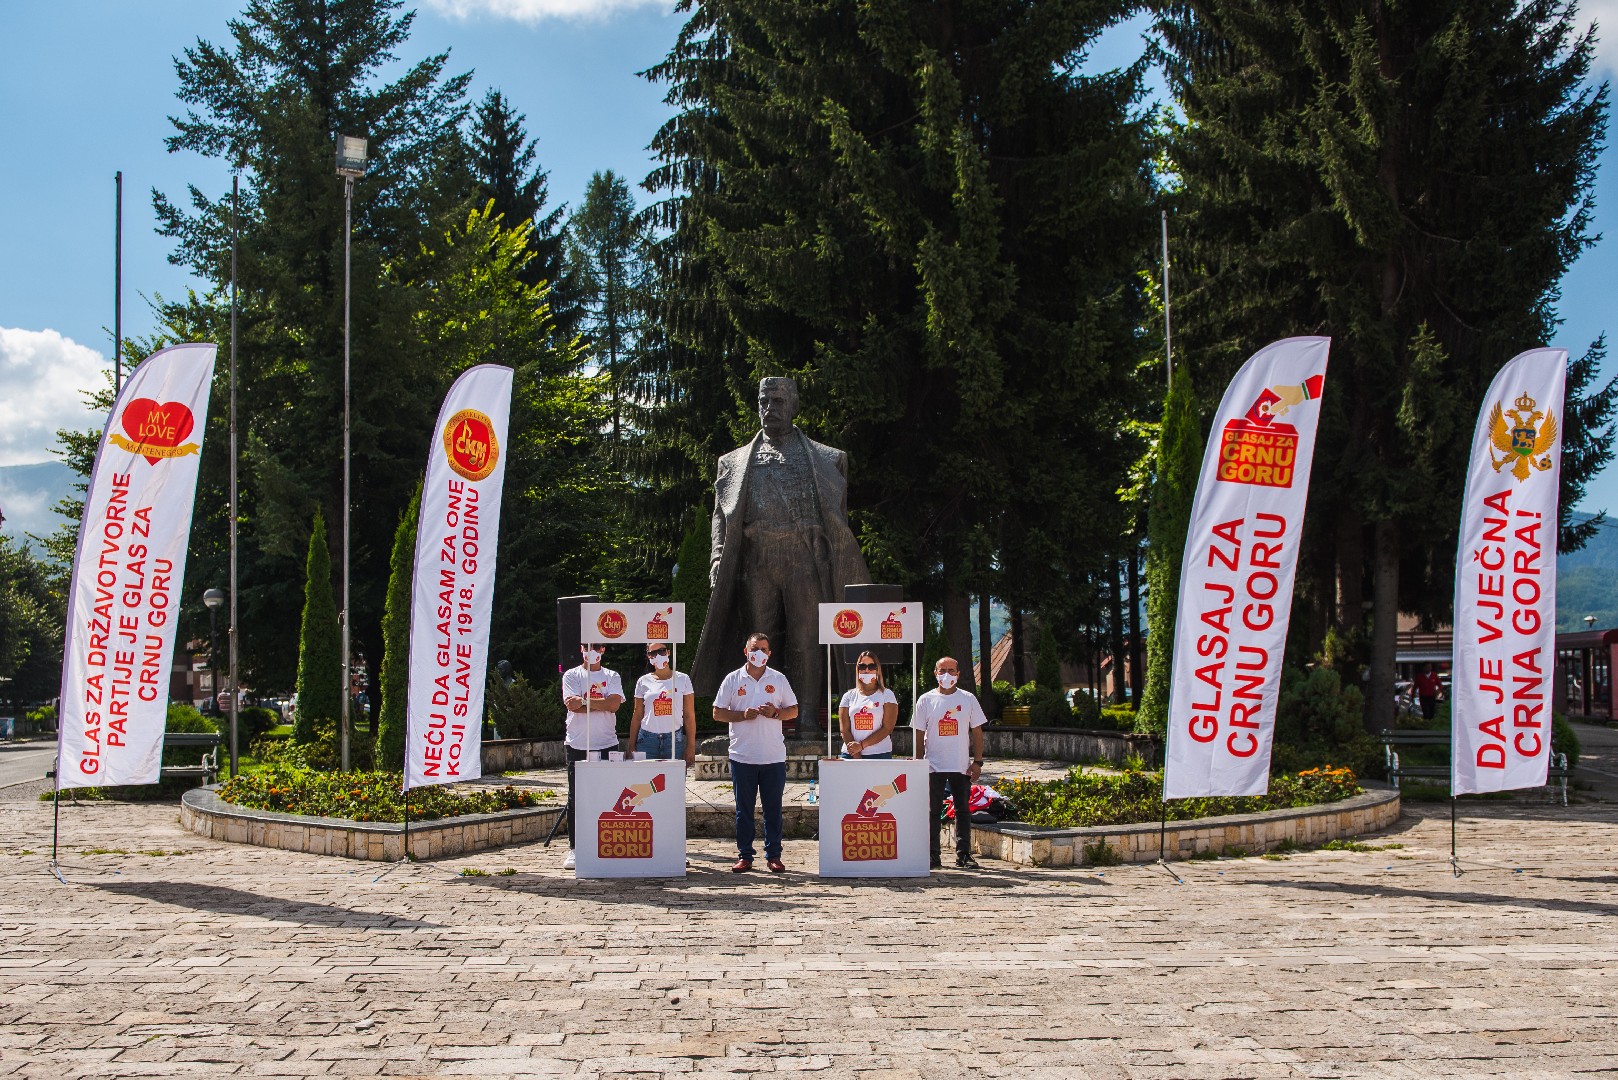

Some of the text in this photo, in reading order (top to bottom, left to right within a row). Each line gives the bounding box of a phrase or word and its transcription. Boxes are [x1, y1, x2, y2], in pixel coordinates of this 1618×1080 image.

[139, 423, 175, 440] LOVE
[147, 411, 170, 425] MY
[1225, 432, 1294, 447] GLASAJ ZA
[125, 442, 183, 457] MONTENEGRO
[1221, 461, 1291, 485] GORU
[1223, 443, 1294, 466] CRNU
[461, 488, 480, 574] GODINU
[80, 473, 130, 775] GLAS ZA DRŽAVOTVORNE
[107, 507, 152, 747] PARTIJE JE GLAS ZA
[138, 559, 173, 701] CRNU GORU
[424, 480, 464, 777] NEĆU DA GLASAM ZA ONE
[457, 584, 474, 635] 1918.
[1188, 518, 1244, 743] GLASAJ ZA
[1474, 489, 1512, 769] DA JE VJEČNA
[1512, 510, 1543, 757] CRNA GORA!
[1226, 513, 1286, 758] CRNU GORU
[454, 644, 471, 717] SLAVE
[446, 724, 465, 776] KOJI
[600, 830, 650, 842] CRNU
[600, 844, 650, 856] GORU
[844, 823, 880, 831] GLASAJ
[844, 831, 894, 845] CRNU
[845, 845, 896, 859] GORU
